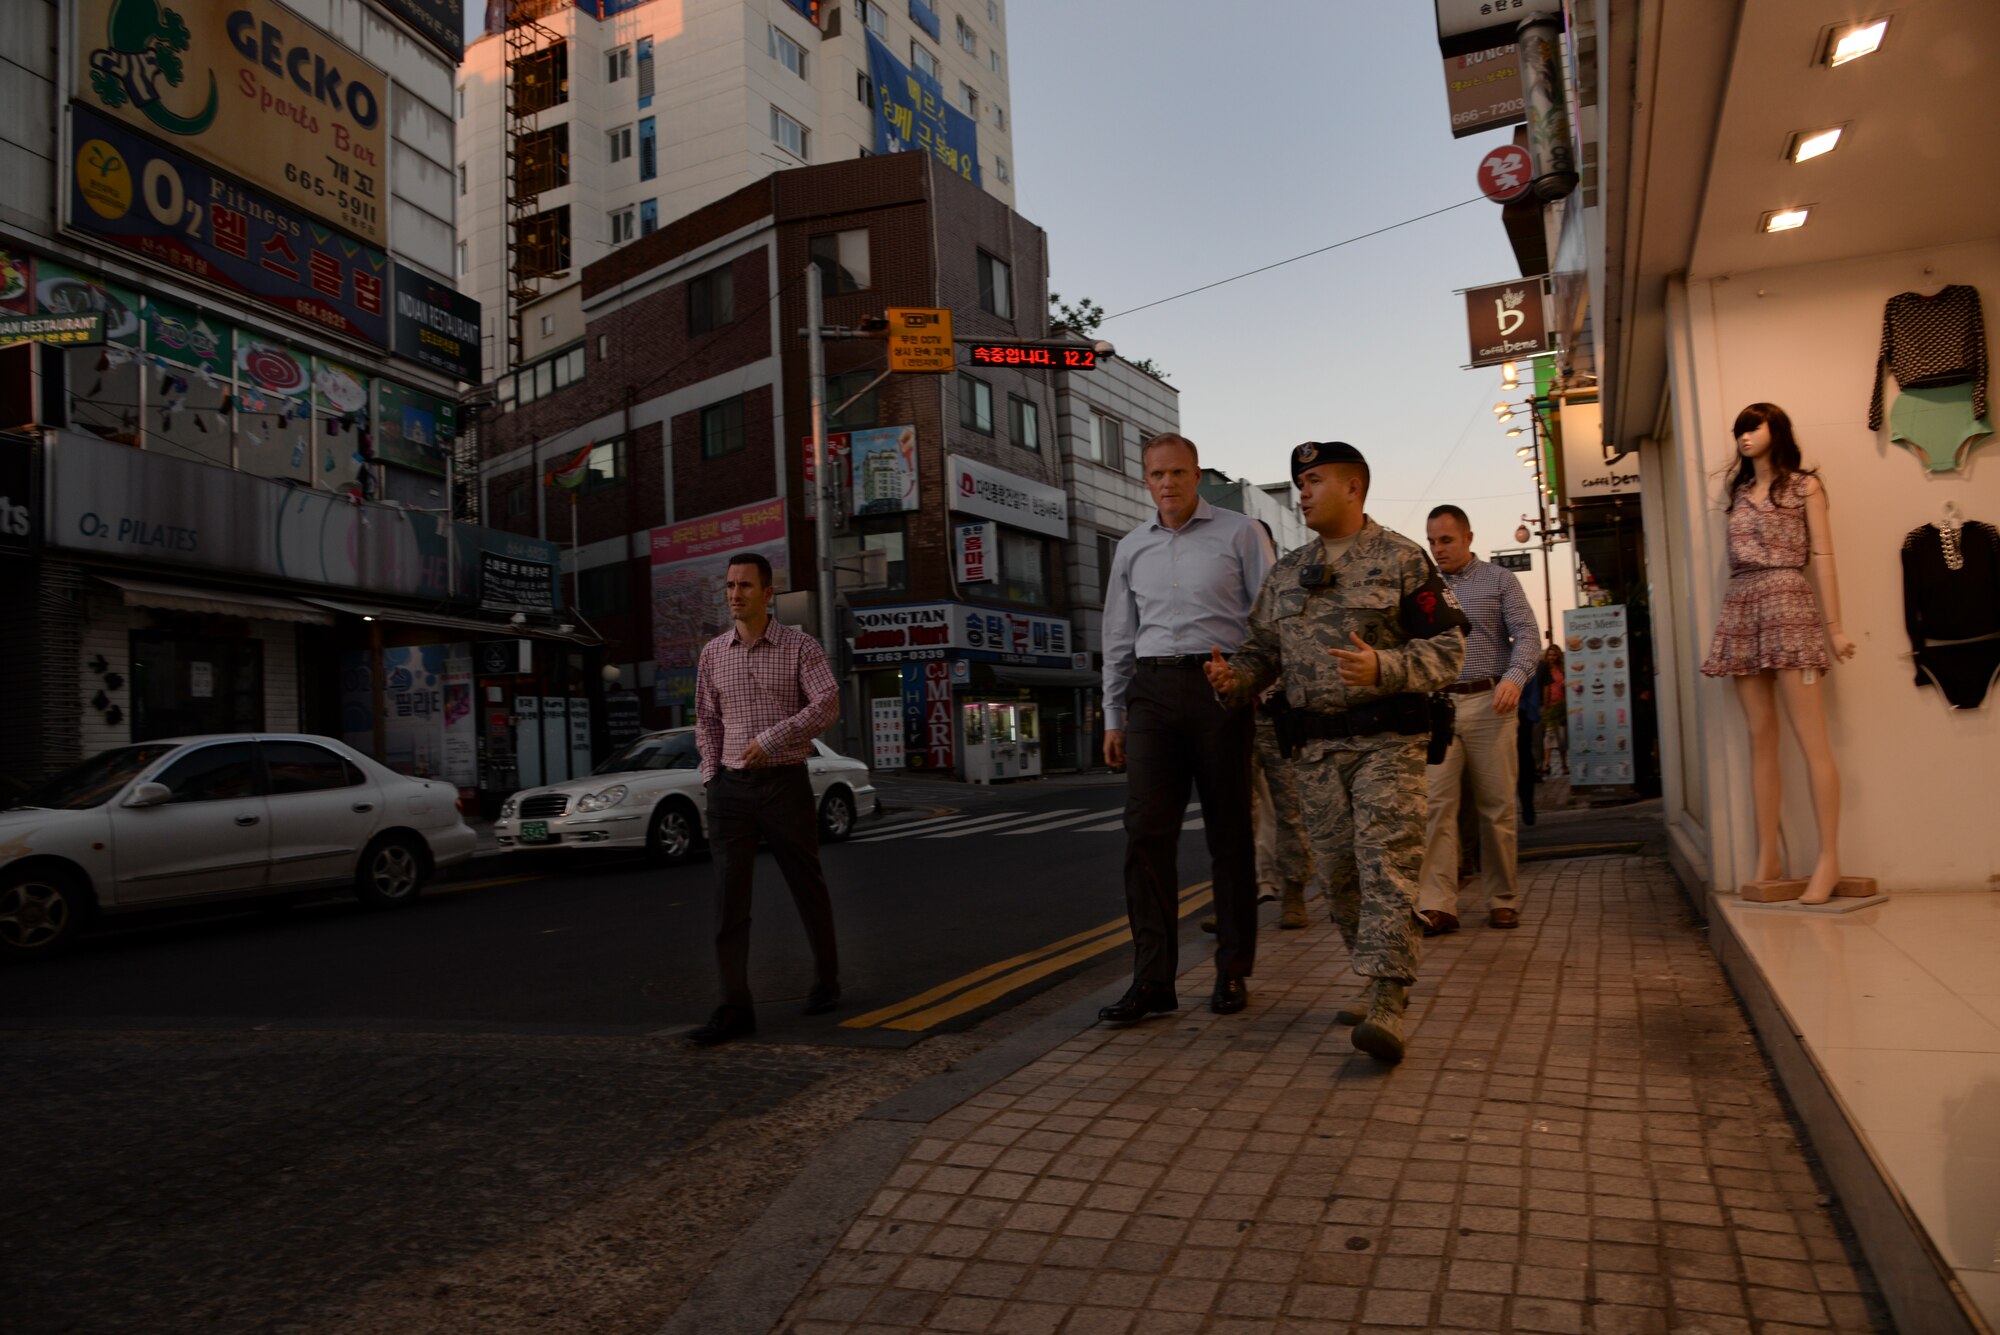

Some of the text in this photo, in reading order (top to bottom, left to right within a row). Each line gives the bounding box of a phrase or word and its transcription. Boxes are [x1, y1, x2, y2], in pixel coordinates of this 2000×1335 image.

[227, 10, 378, 130] GECKO
[239, 69, 377, 167] Sports Bar
[1453, 98, 1526, 125] 666-7203
[209, 177, 301, 237] Fitness
[285, 163, 377, 224] 665-5911
[211, 203, 382, 317] 헬스클럽
[22, 315, 99, 333] RESTAURANT
[973, 346, 1095, 368] 속중입니다. 12.2
[117, 518, 198, 551] PILATES
[965, 536, 984, 580] 홈마트
[856, 609, 945, 627] SONGTAN
[865, 650, 945, 663] T.663-0339
[925, 662, 949, 679] CJ
[927, 680, 951, 768] MART
